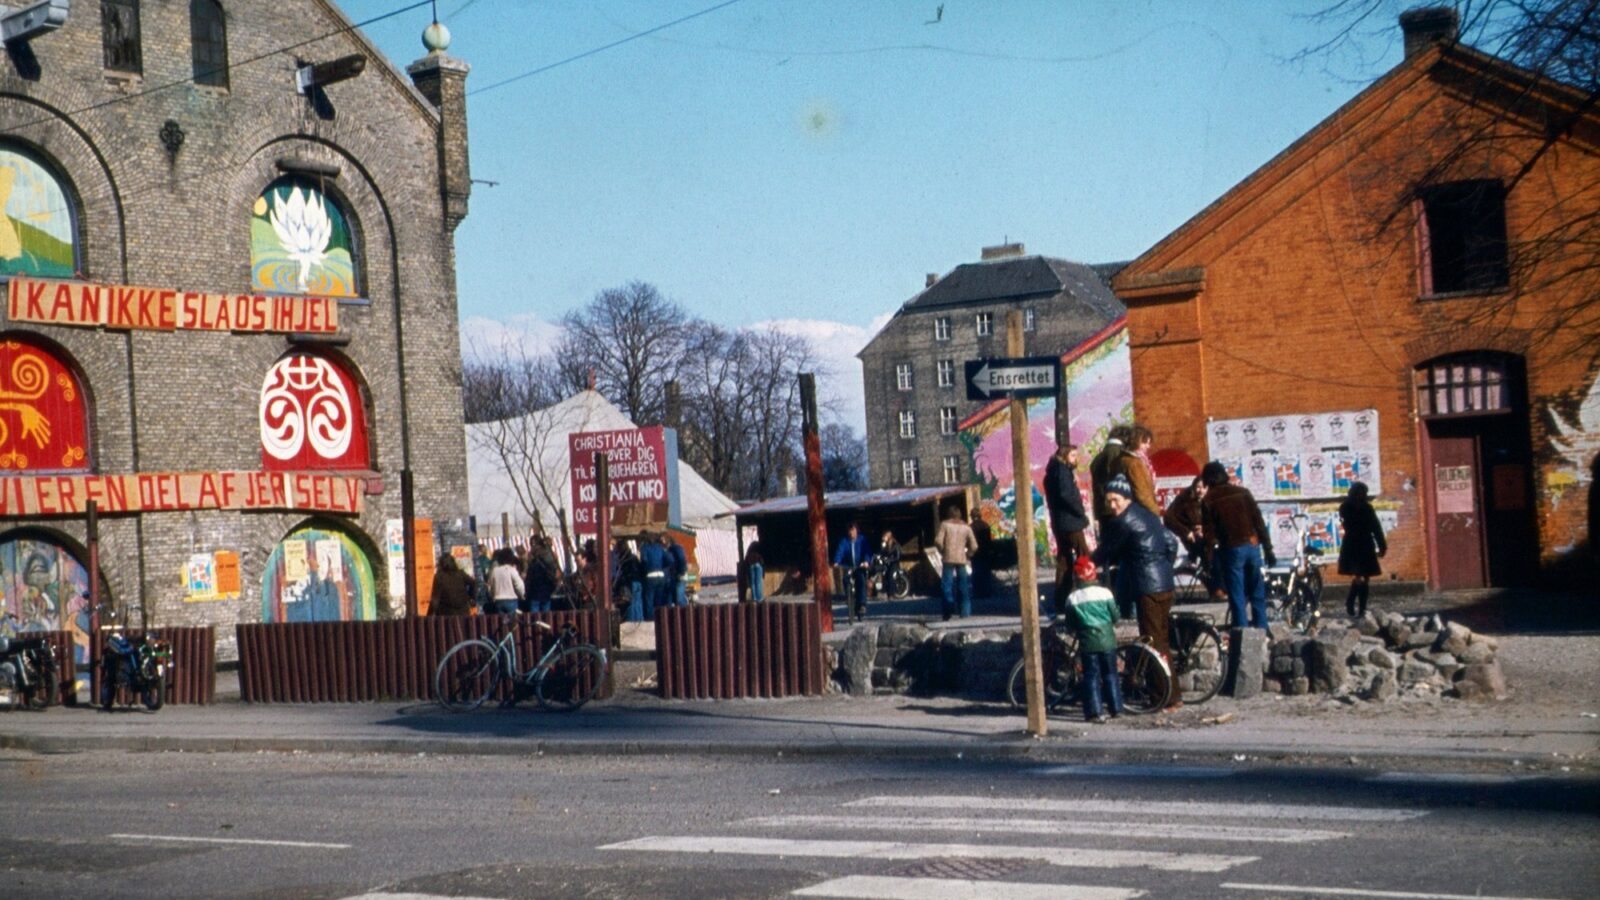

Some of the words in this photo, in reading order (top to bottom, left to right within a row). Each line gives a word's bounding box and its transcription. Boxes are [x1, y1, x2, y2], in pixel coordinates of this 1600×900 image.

[27, 281, 101, 322] KAN
[108, 287, 177, 328] IKKE
[235, 294, 266, 330] OS
[273, 297, 337, 332] IHJEL
[989, 369, 1050, 386] Ensrettet
[574, 430, 645, 451] CHRISTIANIA
[637, 446, 655, 461] DIG
[36, 476, 78, 513] ER
[84, 475, 128, 512] EN
[139, 474, 190, 511] DEL
[199, 472, 236, 509] AF
[245, 472, 286, 506] JER
[296, 473, 359, 513] SELV
[638, 479, 664, 500] INFO
